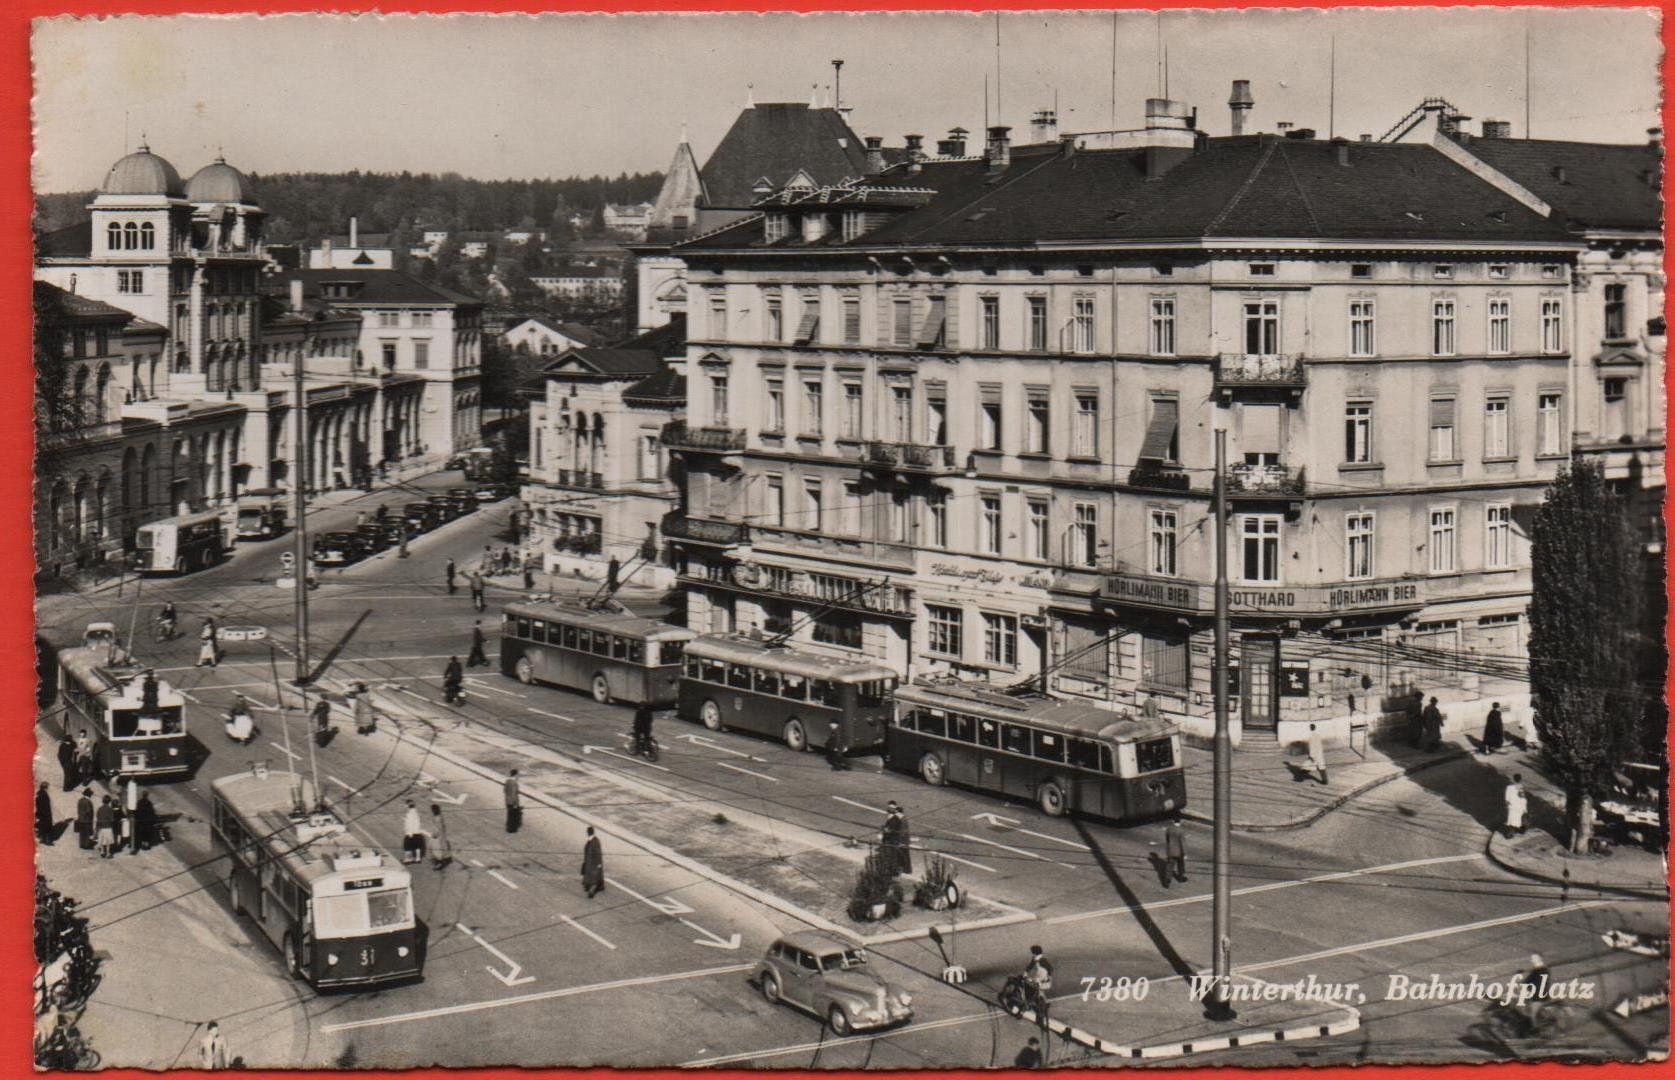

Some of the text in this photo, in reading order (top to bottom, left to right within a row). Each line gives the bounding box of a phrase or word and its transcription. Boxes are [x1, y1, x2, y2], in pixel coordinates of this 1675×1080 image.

[1168, 586, 1189, 606] BIER
[1225, 591, 1295, 607] GOTTHARD
[1329, 584, 1417, 608] HÜRLIMANN BIER
